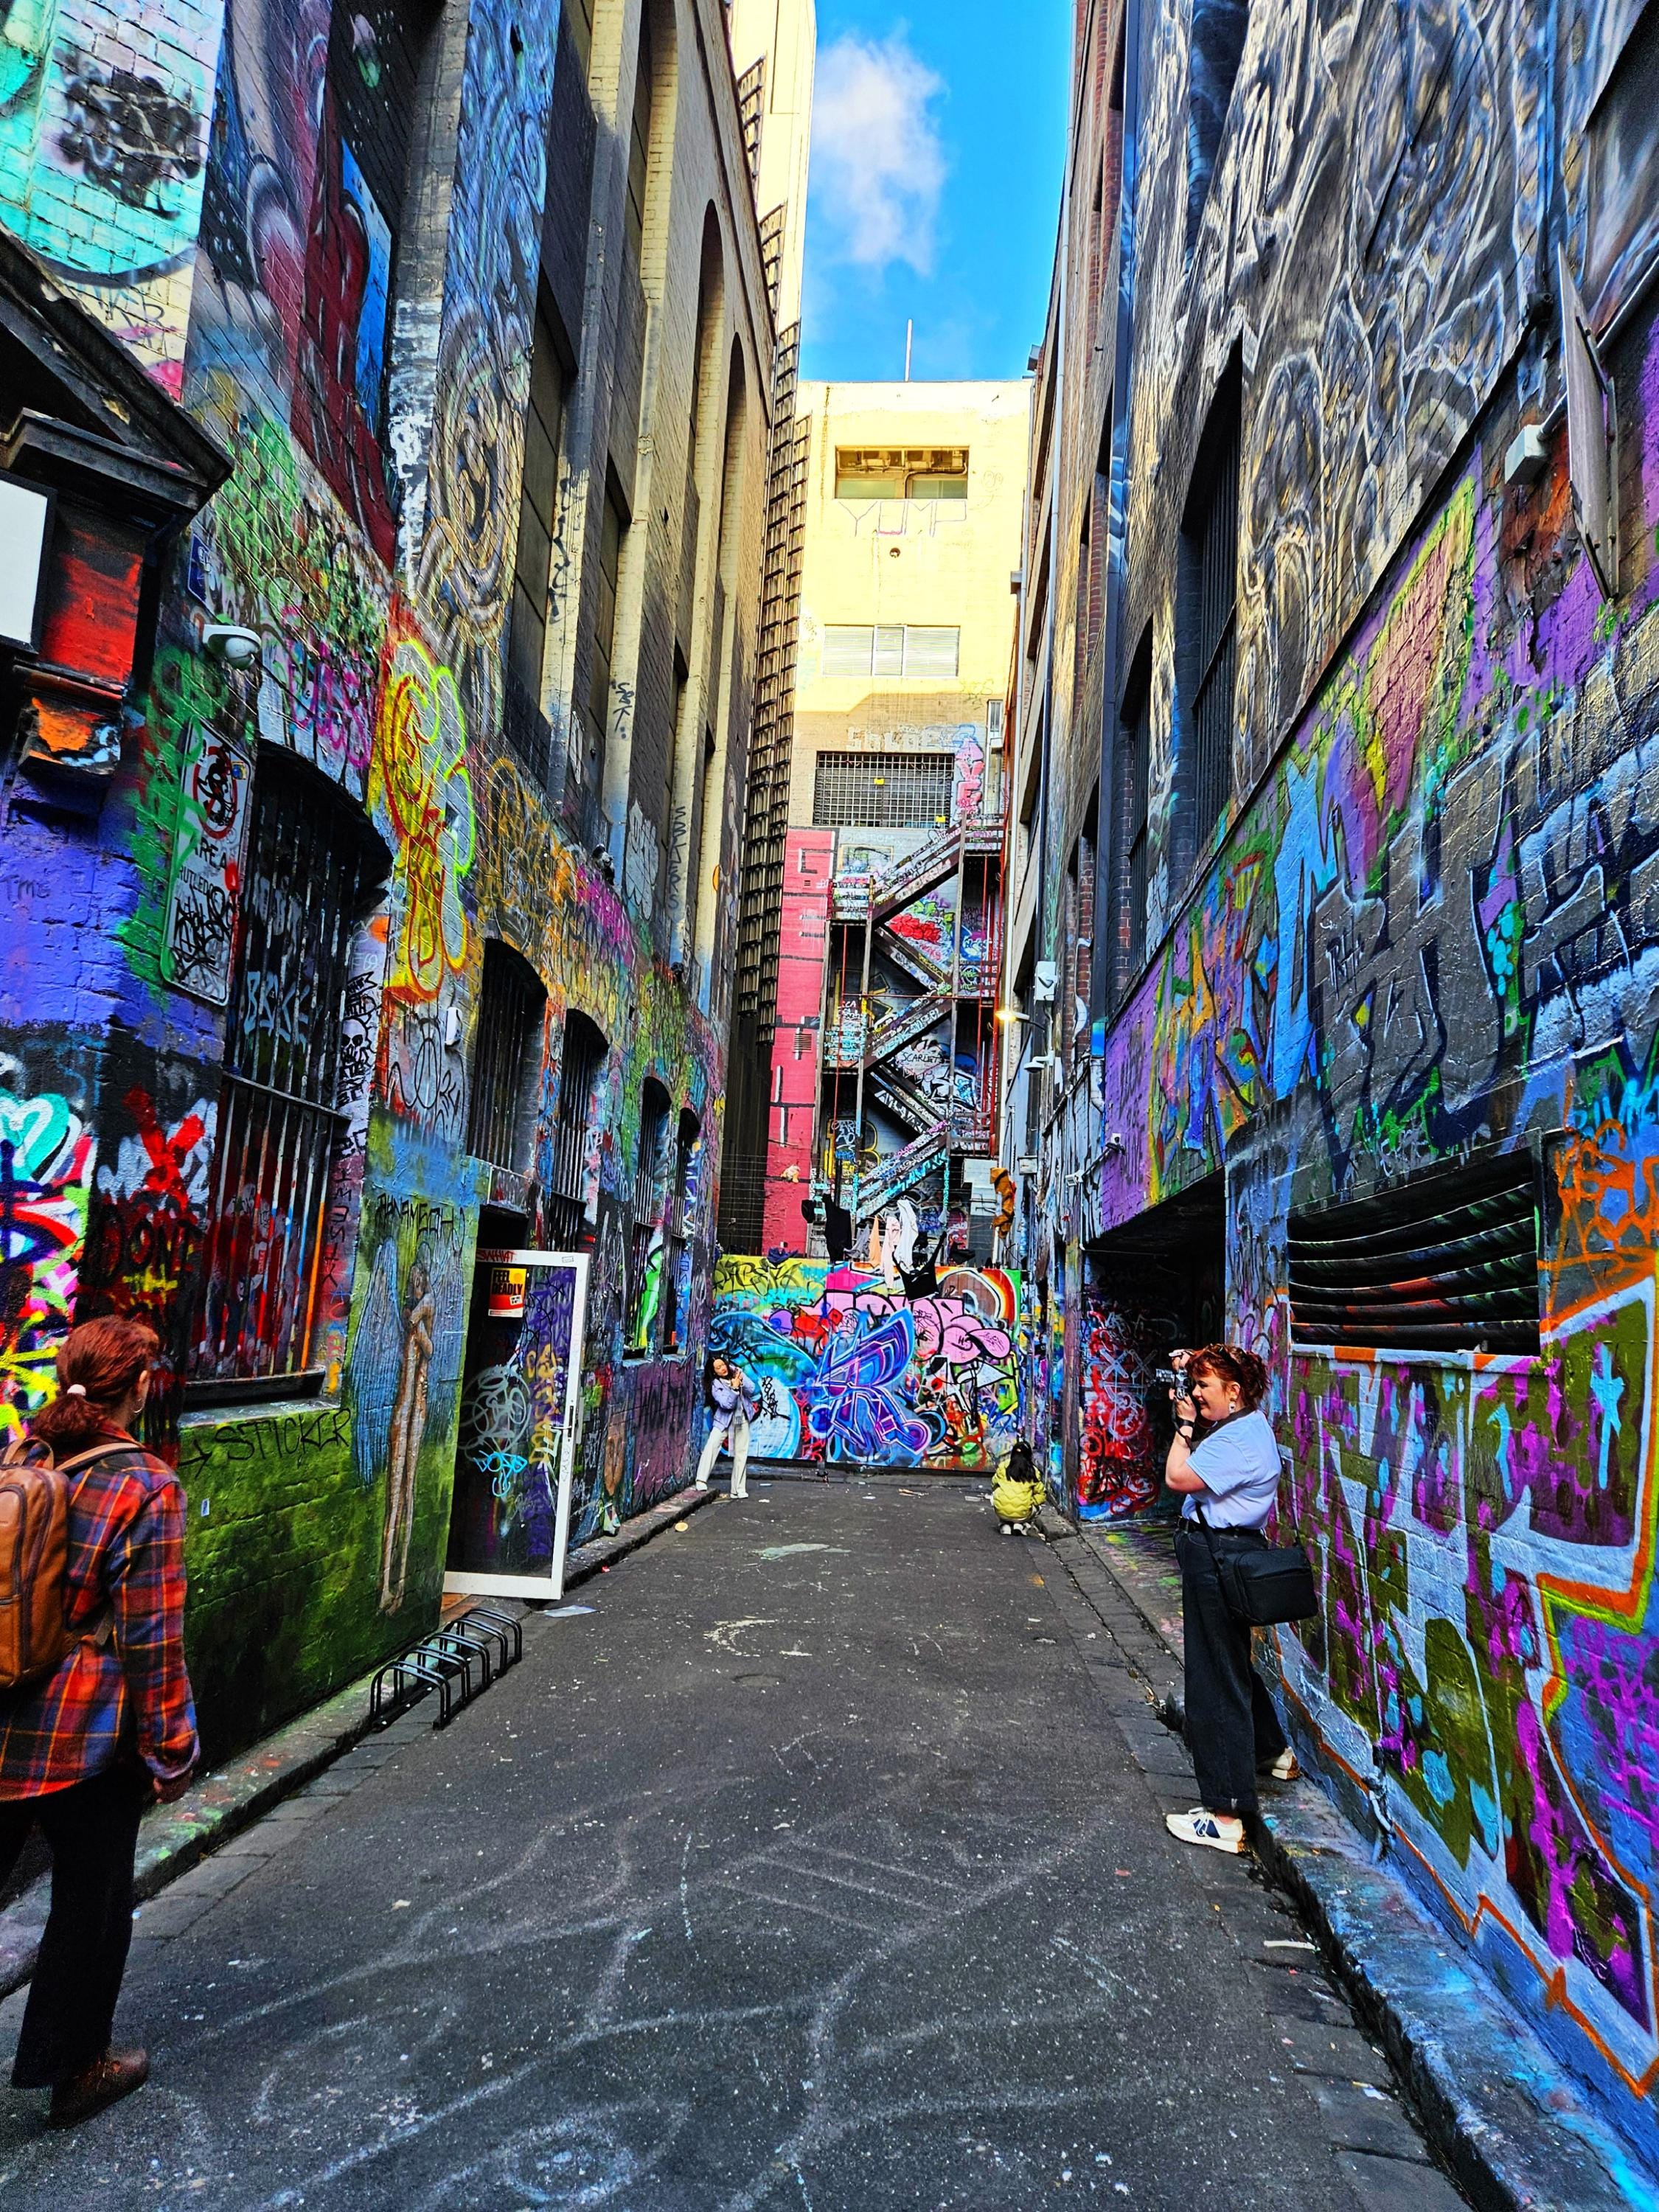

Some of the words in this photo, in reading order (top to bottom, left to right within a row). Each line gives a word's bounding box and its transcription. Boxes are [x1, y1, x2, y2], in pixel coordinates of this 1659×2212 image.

[493, 1269, 510, 1283] FEEL
[491, 1282, 524, 1295] DEADLY
[214, 1408, 351, 1461] STICKER
